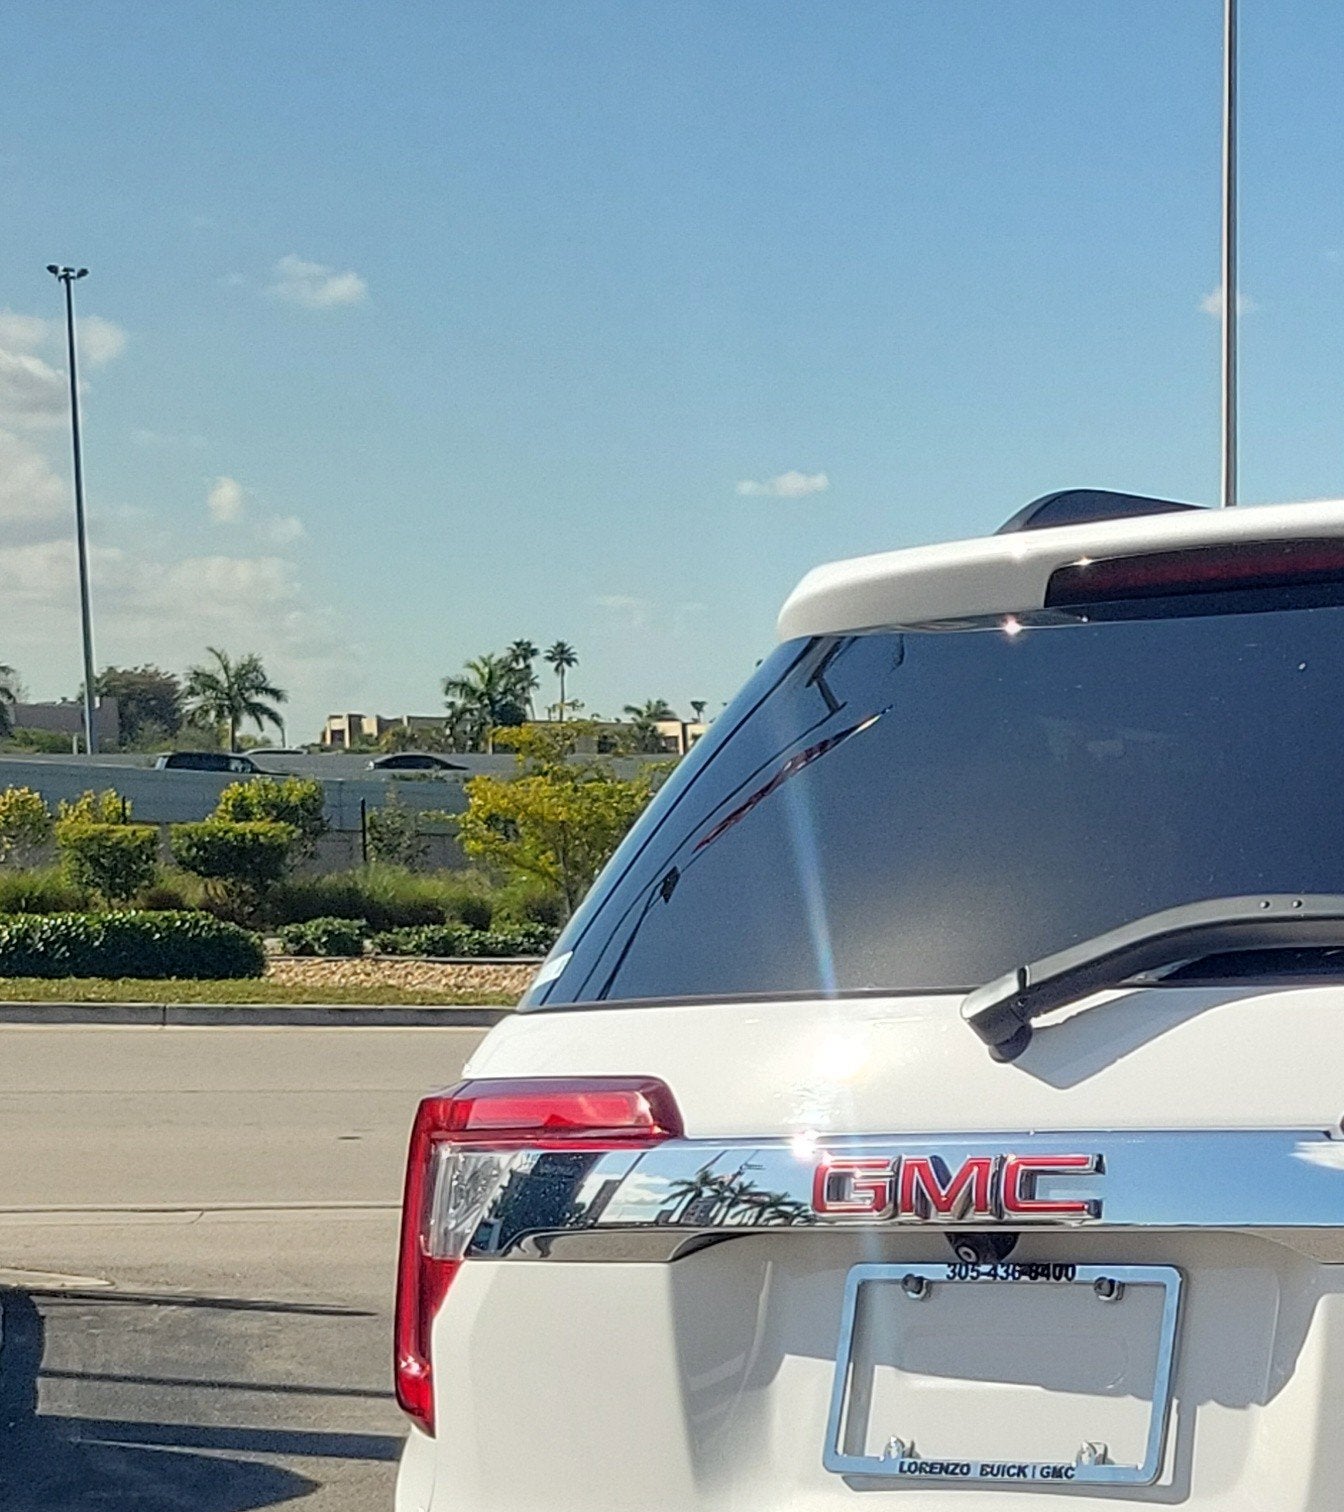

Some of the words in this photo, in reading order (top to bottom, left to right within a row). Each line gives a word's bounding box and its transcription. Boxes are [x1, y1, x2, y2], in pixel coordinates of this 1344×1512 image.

[811, 1153, 1106, 1220] GMC
[945, 1262, 1077, 1281] 305-436-8400
[898, 1460, 971, 1476] LORENZO
[979, 1463, 1029, 1478] BUICK
[1040, 1465, 1076, 1480] GMC
